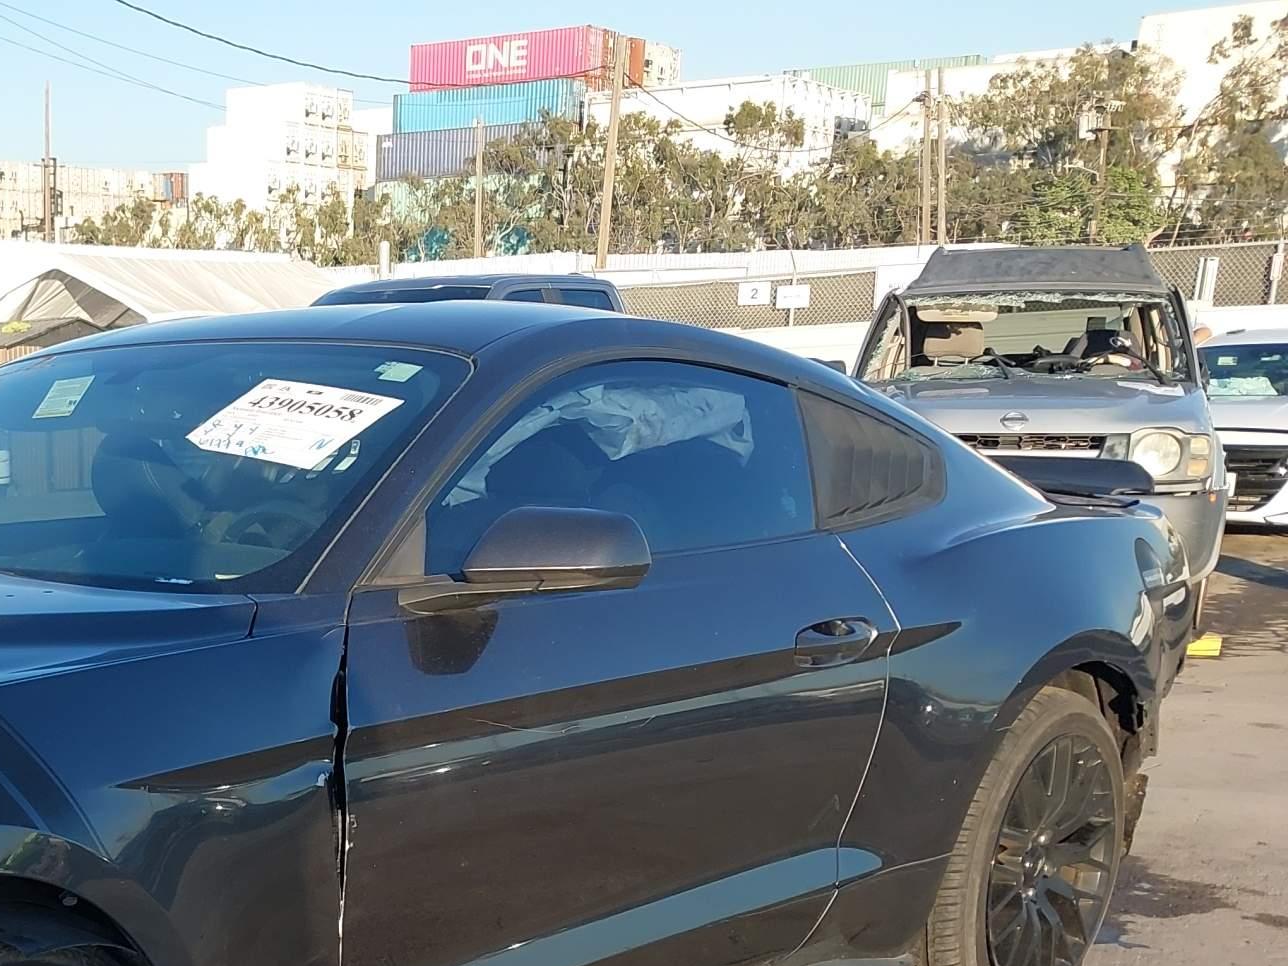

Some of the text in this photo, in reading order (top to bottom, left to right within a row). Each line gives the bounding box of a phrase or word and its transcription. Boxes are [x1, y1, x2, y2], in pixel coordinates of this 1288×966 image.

[466, 40, 528, 72] ONE
[750, 288, 758, 299] 2
[248, 395, 363, 422] 43905058
